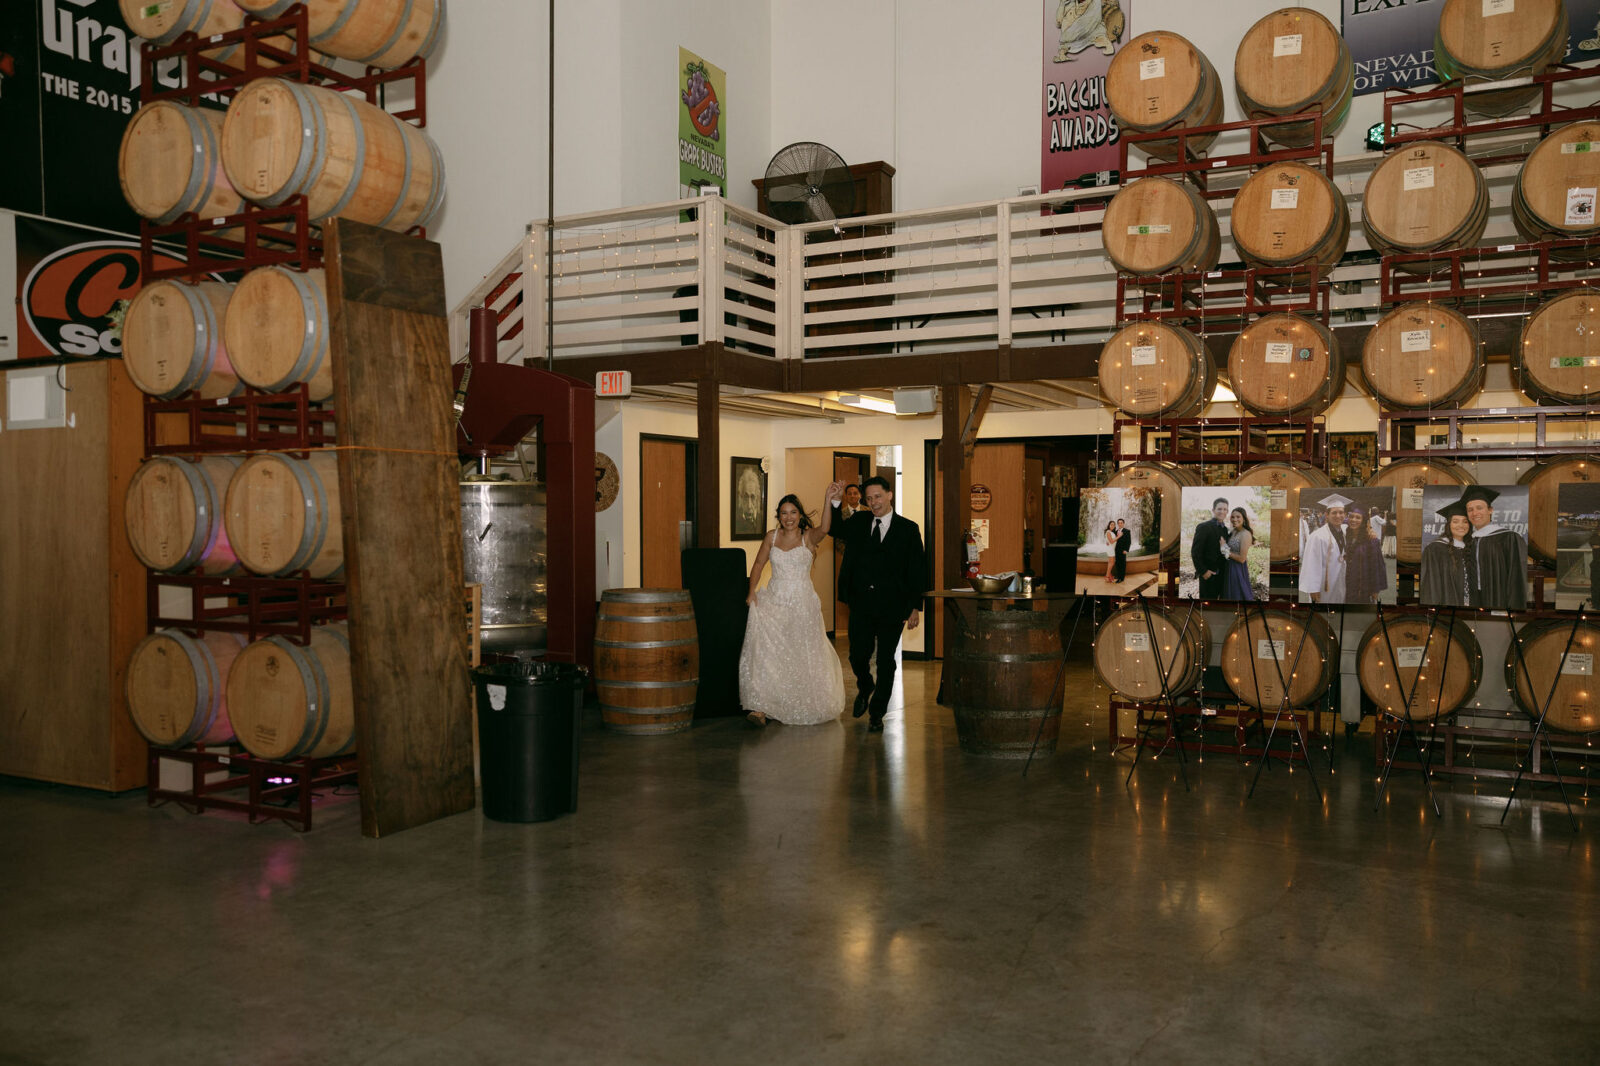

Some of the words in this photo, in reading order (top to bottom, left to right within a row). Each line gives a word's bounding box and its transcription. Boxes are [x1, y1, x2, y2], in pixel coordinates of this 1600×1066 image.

[1354, 49, 1435, 76] NEVAD
[1354, 73, 1385, 90] OF
[1390, 65, 1440, 83] WIN
[42, 71, 80, 99] THE
[86, 86, 132, 115] 2015
[1047, 75, 1109, 117] BACCHU
[1050, 113, 1120, 153] AWARDS
[679, 137, 700, 169] GRAPE
[701, 148, 725, 181] BUSTERS
[601, 371, 625, 394] EXIT
